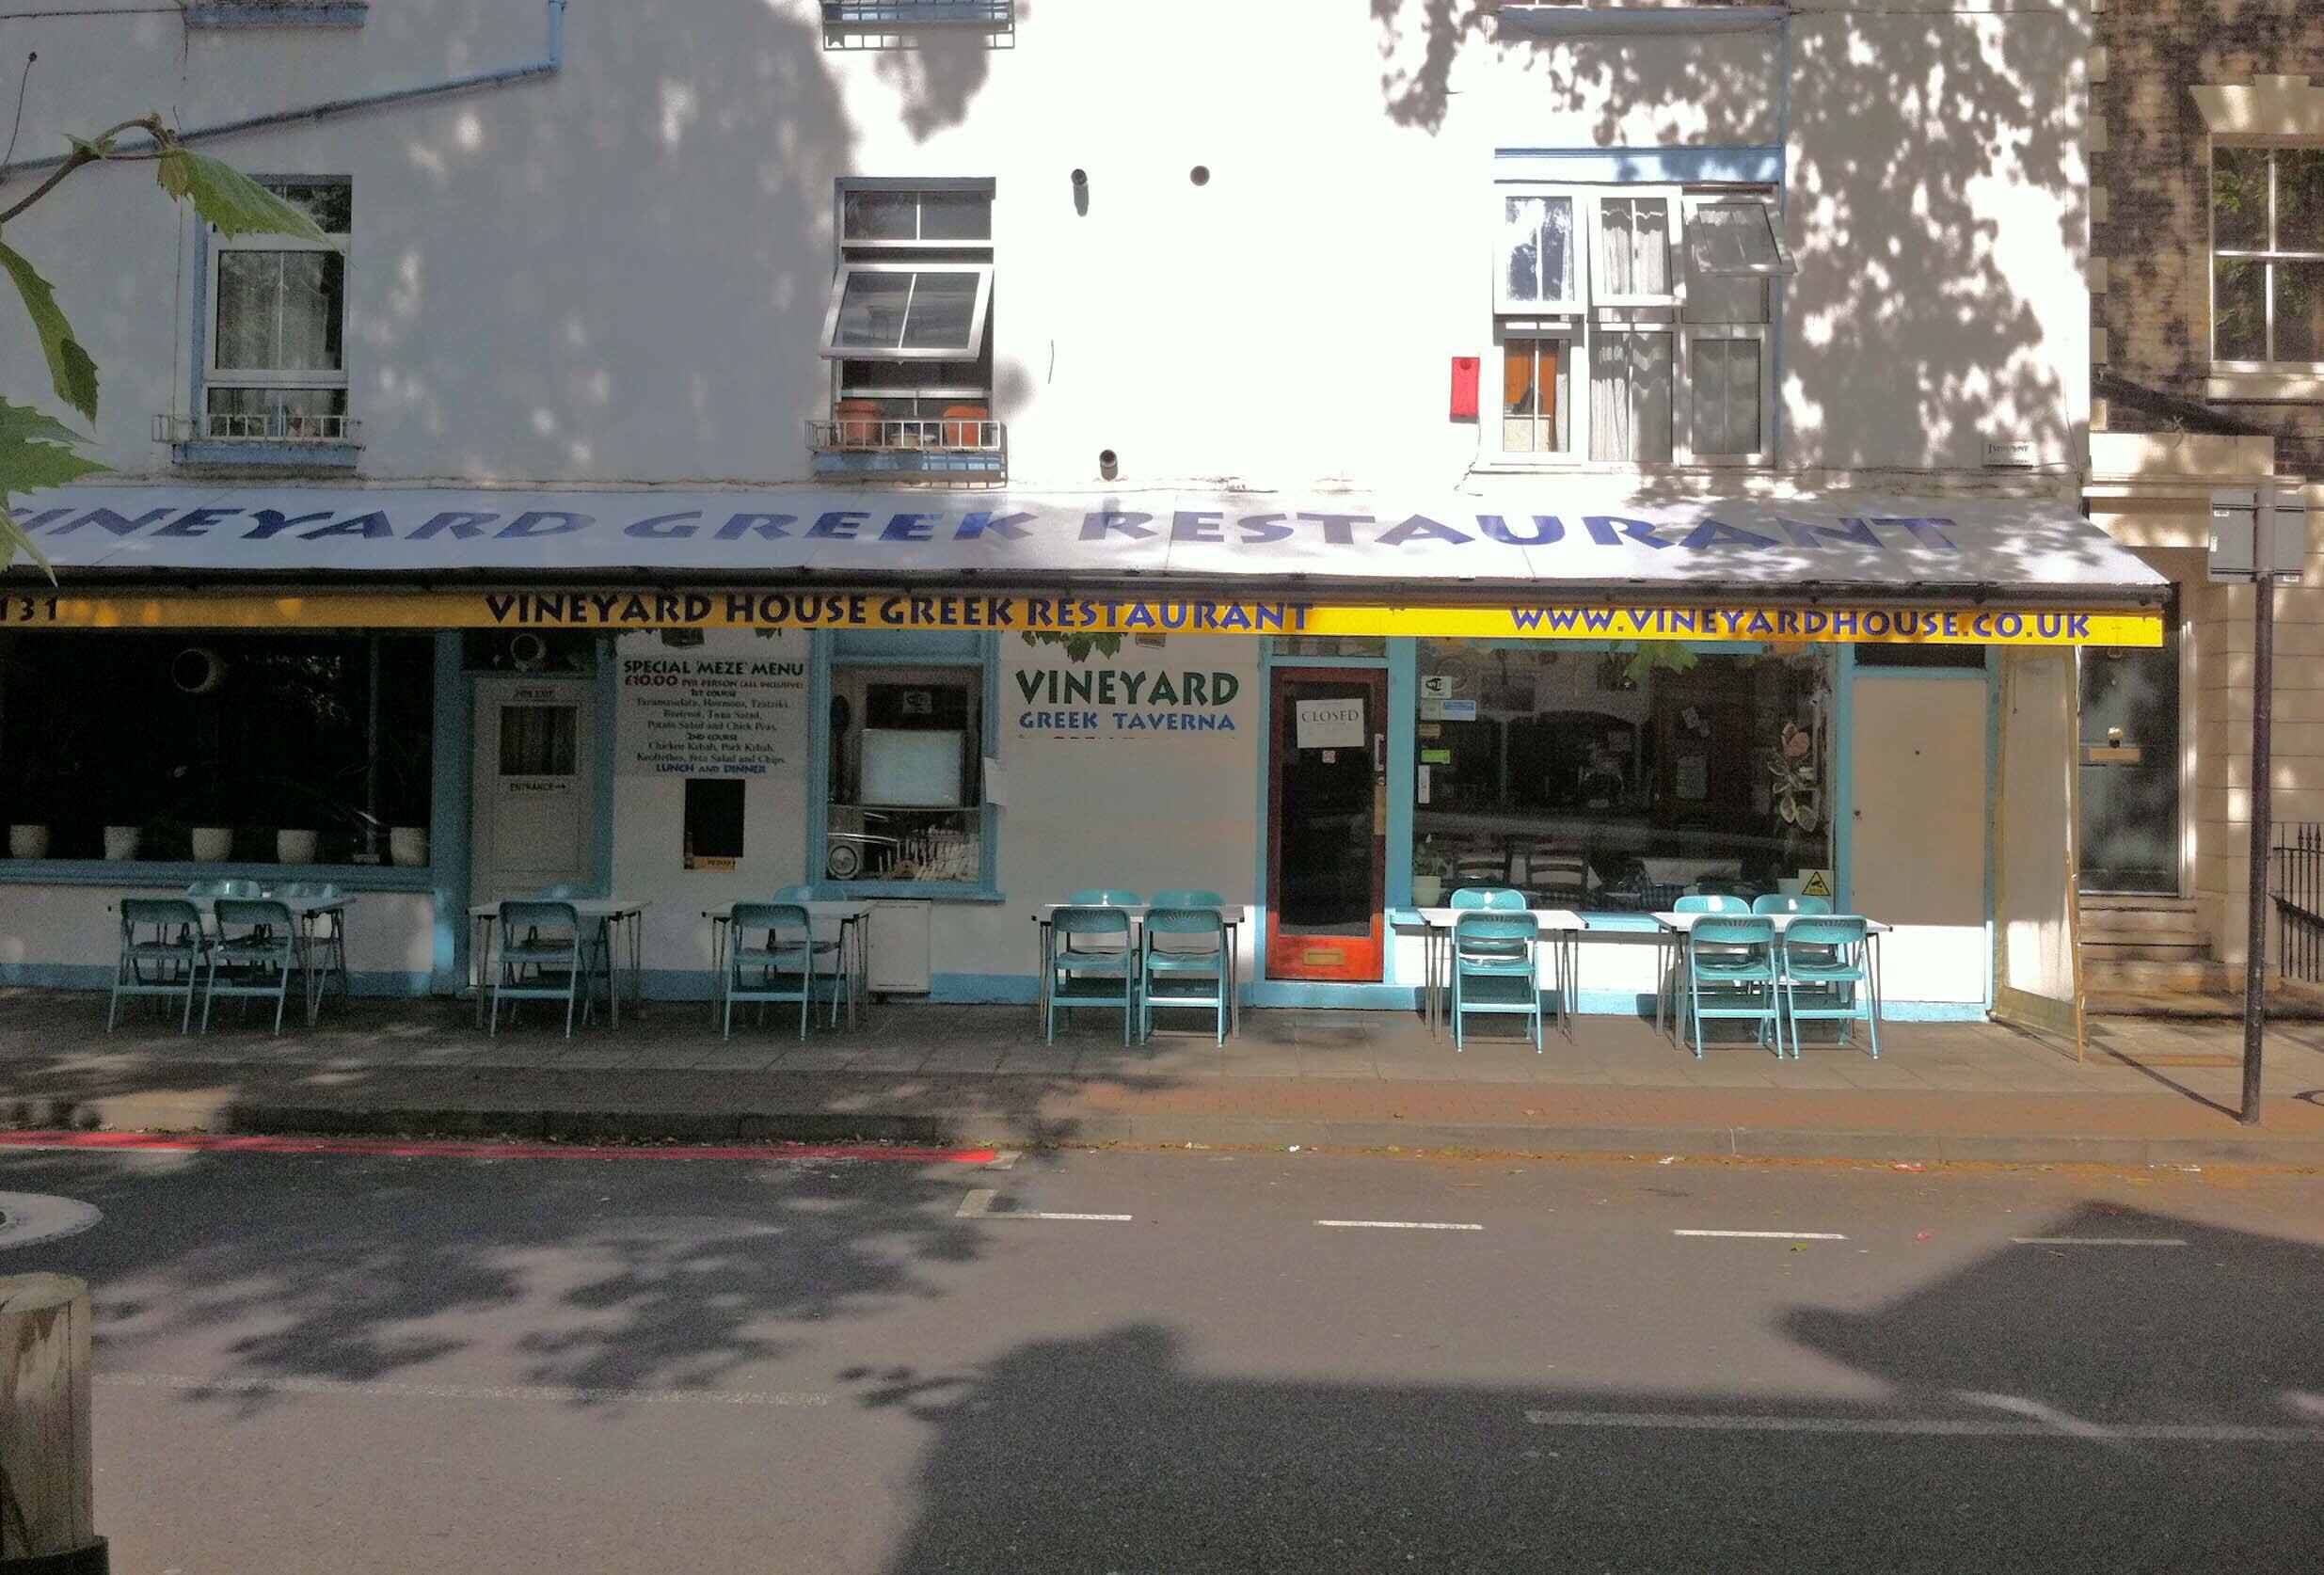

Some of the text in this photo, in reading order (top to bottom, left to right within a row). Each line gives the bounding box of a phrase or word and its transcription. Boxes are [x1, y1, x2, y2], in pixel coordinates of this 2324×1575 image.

[624, 511, 1038, 542] GREEK
[1078, 511, 1957, 551] RESTAURANT
[0, 597, 57, 621] 131
[485, 594, 1313, 630] VINEYARD HOUSE GREEK RESTAURANT
[1511, 606, 2090, 639] WWW.VINEYARDHOUSE.CO.UK
[624, 660, 691, 674] SPECIAL
[752, 662, 804, 676] MENU
[625, 675, 678, 687] £10.00
[701, 679, 738, 689] PERSON
[1015, 669, 1239, 706] VINEYARD
[1018, 711, 1235, 731] GREEK TAVERNA
[1301, 709, 1359, 723] CLOSED
[678, 722, 704, 730] Salad
[706, 722, 724, 731] and
[726, 722, 751, 731] Chick
[710, 754, 736, 763] Salad
[656, 764, 766, 774] LUNCH AND DINNER
[510, 783, 555, 792] ENTRANCE
